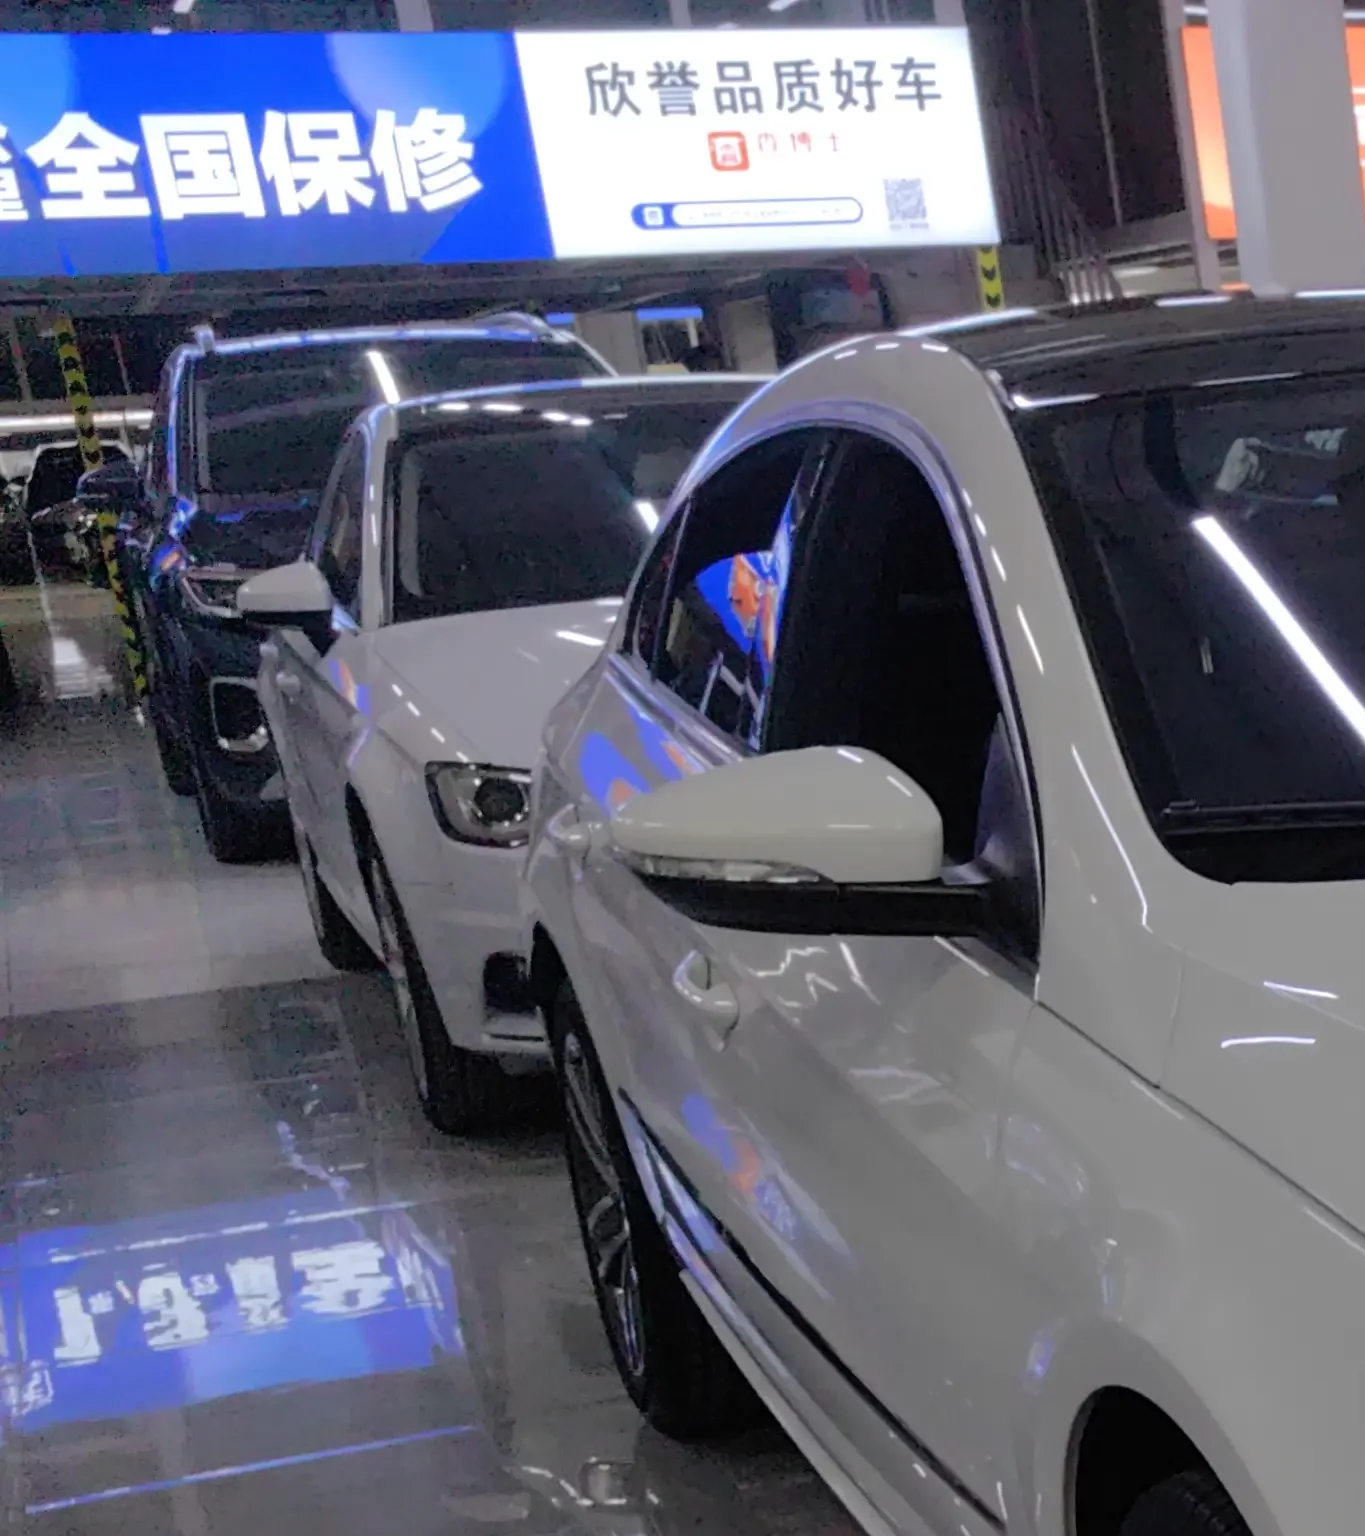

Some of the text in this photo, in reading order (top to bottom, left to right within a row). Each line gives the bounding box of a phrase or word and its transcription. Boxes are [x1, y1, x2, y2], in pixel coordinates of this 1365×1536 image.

[585, 56, 943, 118] 欣誉品质好车
